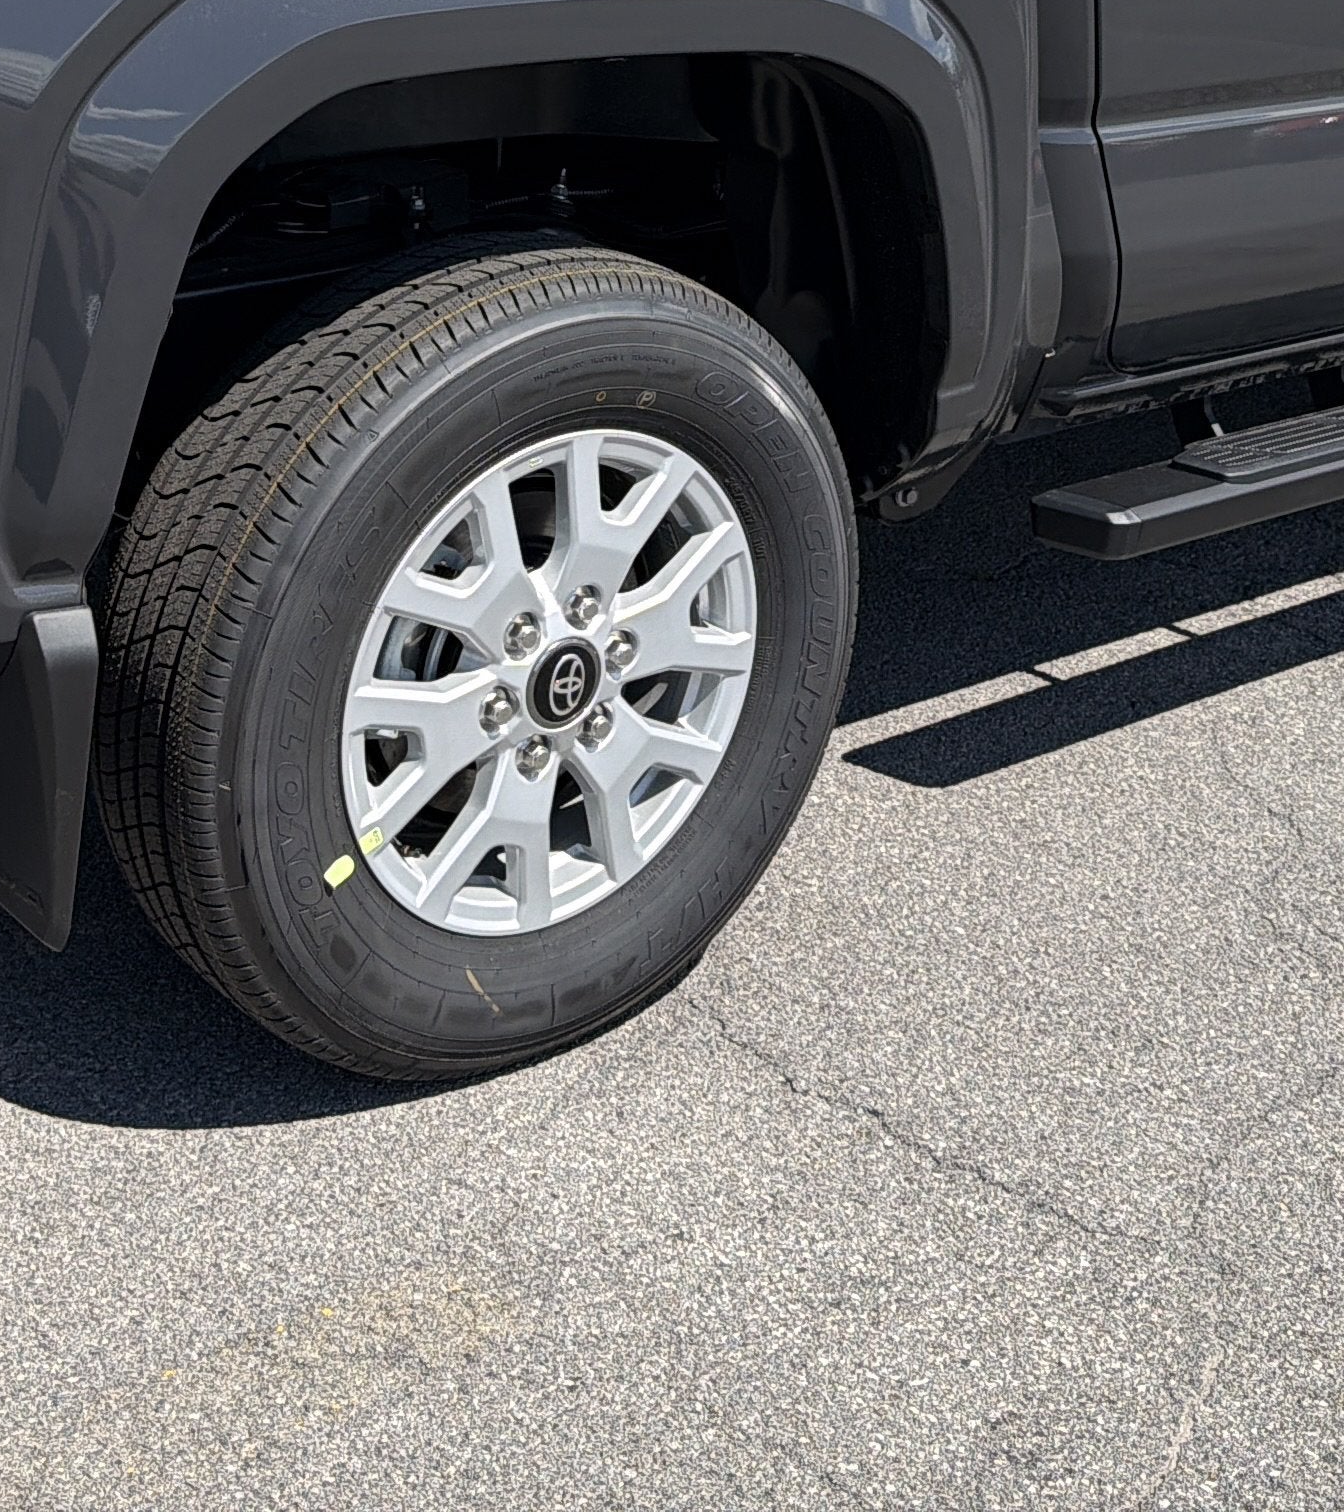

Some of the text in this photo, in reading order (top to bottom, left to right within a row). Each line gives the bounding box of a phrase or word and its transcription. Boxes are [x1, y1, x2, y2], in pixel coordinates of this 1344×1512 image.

[695, 371, 810, 494] OPEN
[758, 513, 835, 836] COUNTRY
[274, 761, 341, 950] TOYO
